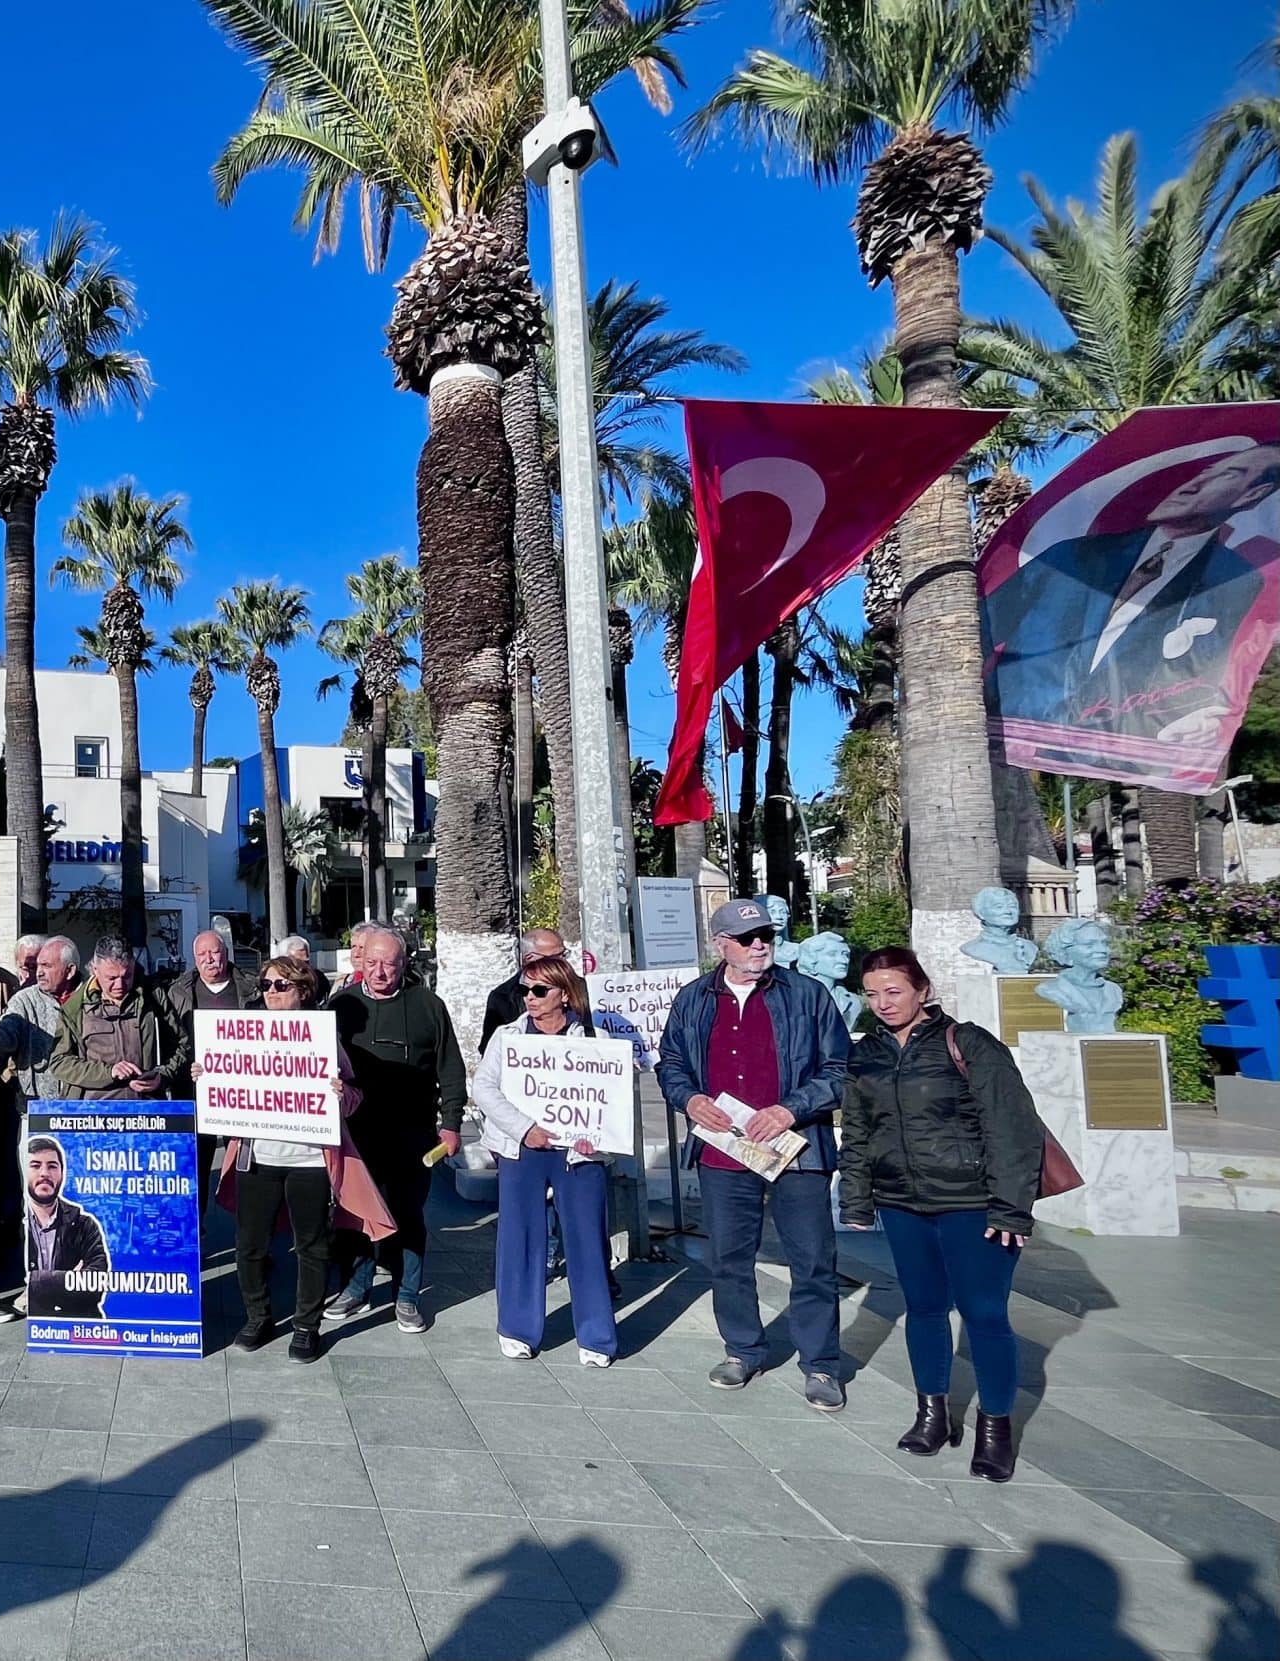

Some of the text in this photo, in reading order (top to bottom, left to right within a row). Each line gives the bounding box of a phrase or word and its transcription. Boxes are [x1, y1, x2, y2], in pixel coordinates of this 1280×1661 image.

[604, 977, 682, 993] Gazetecilik
[598, 999, 622, 1014] Suç
[216, 1019, 312, 1042] HABER ALMA
[601, 1017, 642, 1033] Alican
[204, 1048, 329, 1079] ÖZGÜRLÜĞÜMÜZ
[507, 1047, 623, 1075] Baskı Sömürü
[524, 1073, 608, 1104] Düzenine
[208, 1087, 327, 1115] ENGELLENEMEZ
[49, 1115, 166, 1132] GAZETECİLİK SUÇ DEĞİLDİR
[251, 1121, 259, 1129] VE
[86, 1147, 176, 1171] İSMAİL ARI
[75, 1174, 190, 1195] YALNIZ DEĞİLDİR
[64, 1271, 193, 1295] ONURUMUZDUR.
[31, 1325, 70, 1340] Bodrum
[122, 1330, 148, 1344] Okur
[151, 1329, 198, 1347] İnisiyatifi
